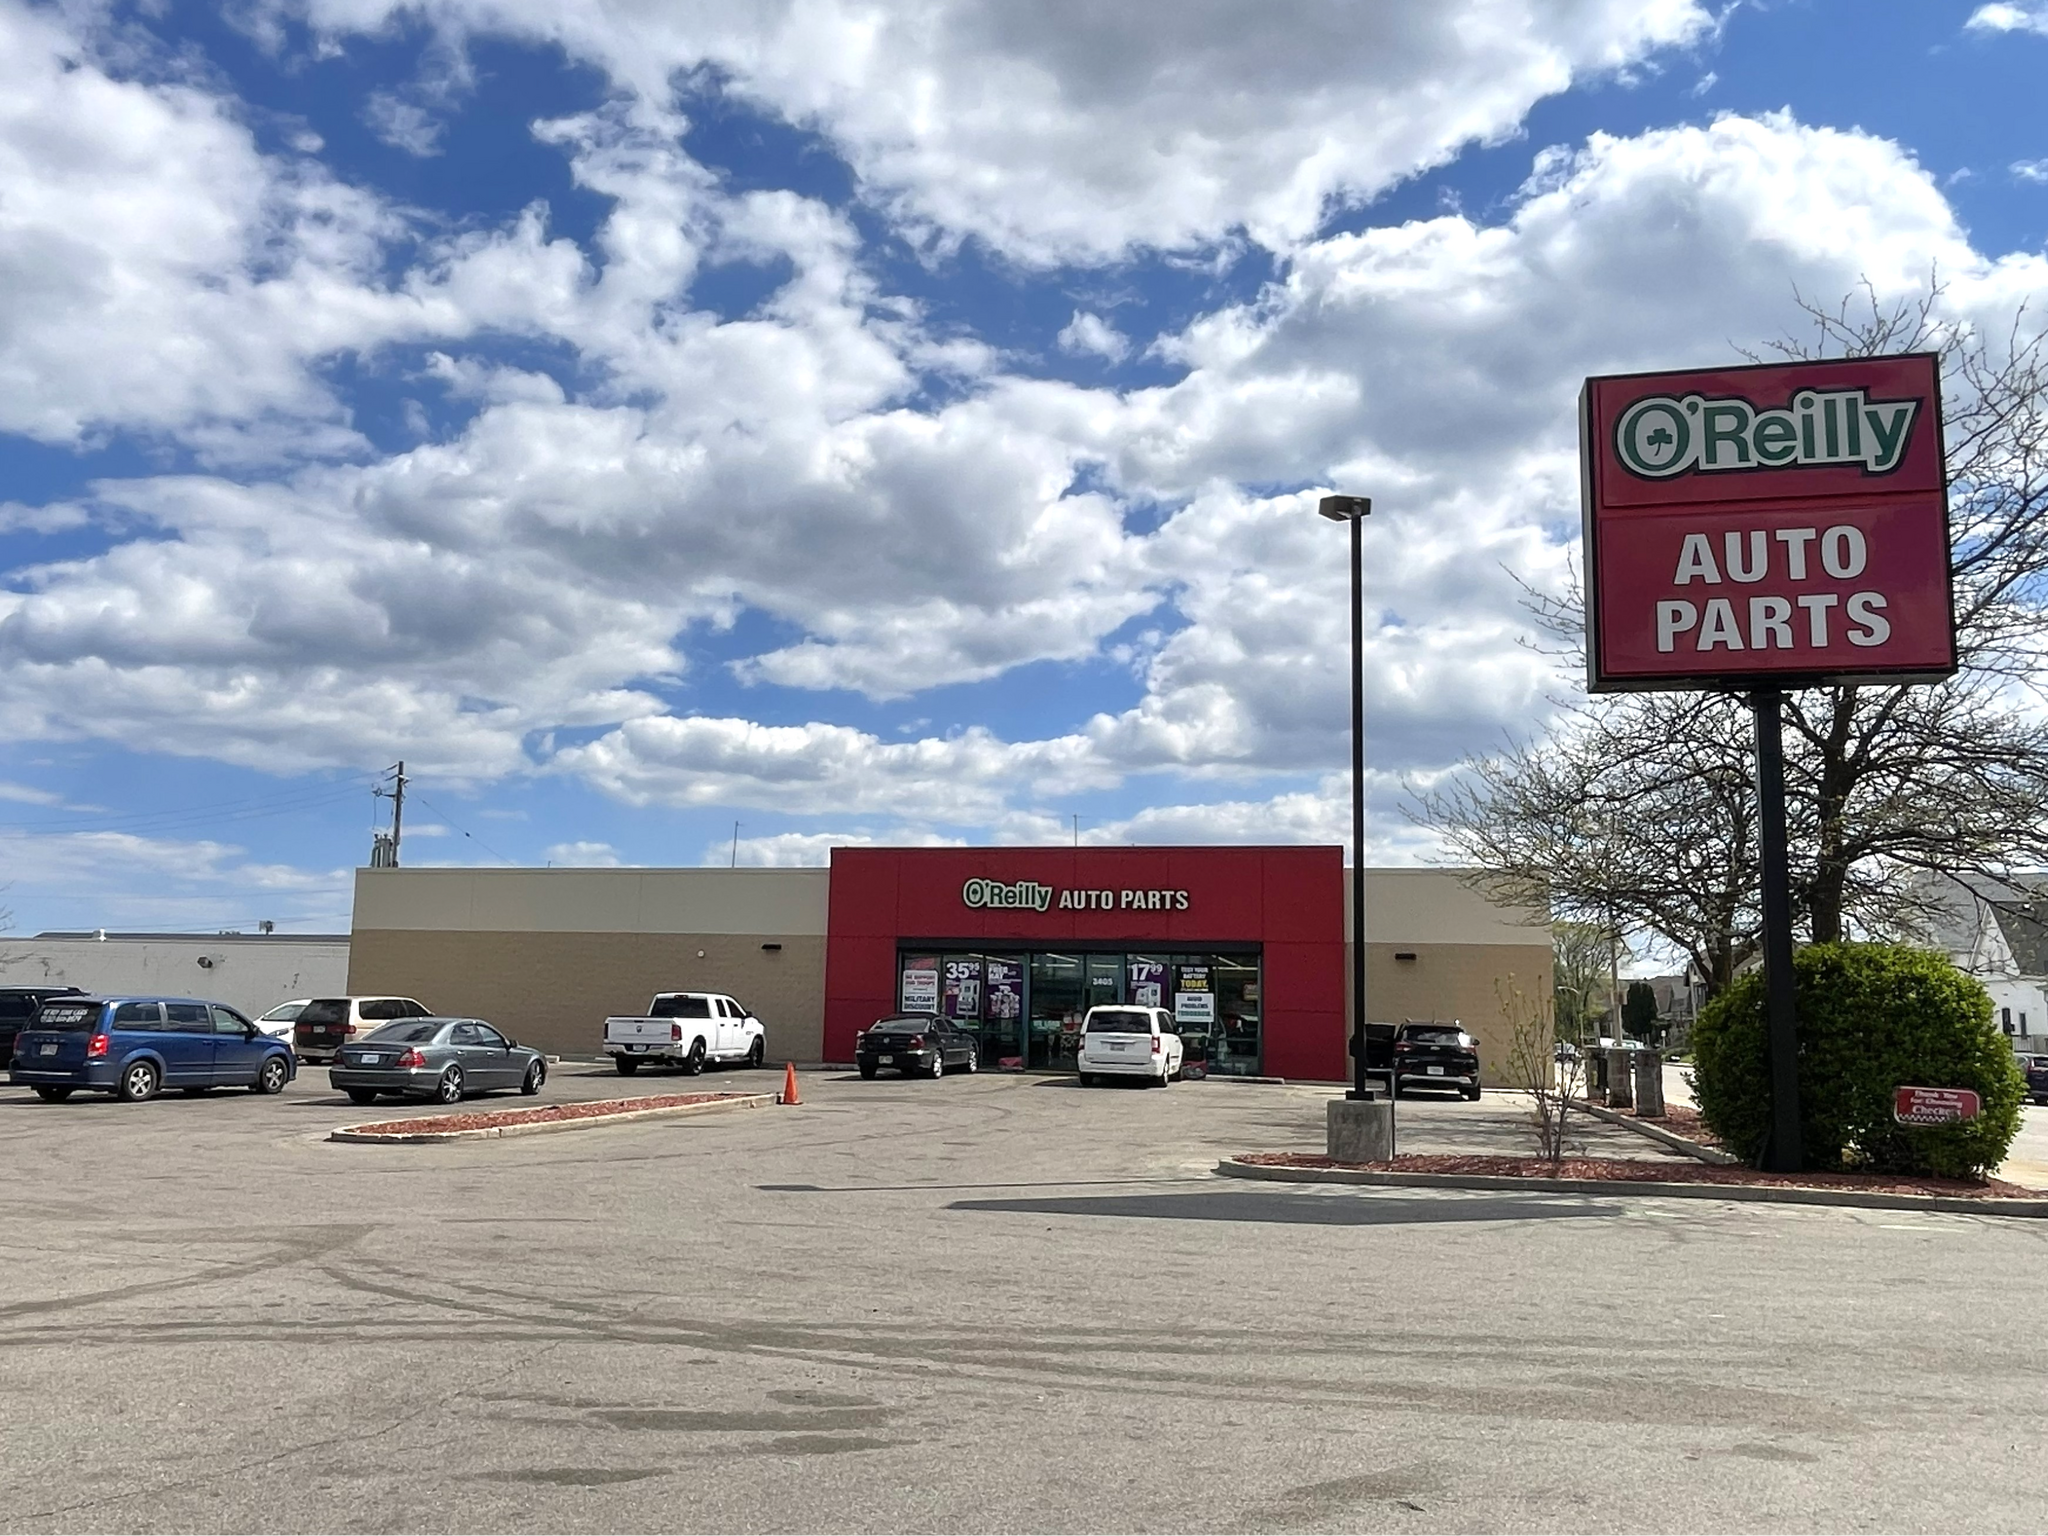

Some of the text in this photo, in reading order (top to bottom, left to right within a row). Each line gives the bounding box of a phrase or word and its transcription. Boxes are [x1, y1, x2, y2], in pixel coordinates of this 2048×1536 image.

[1620, 392, 1912, 474] O'Reilly
[1673, 525, 1868, 586] AUTO
[1656, 591, 1892, 653] PARTS
[965, 880, 1189, 911] O'Reilly AUTO PARTS
[904, 995, 935, 1003] MILITARY
[1180, 979, 1209, 988] TODAY.
